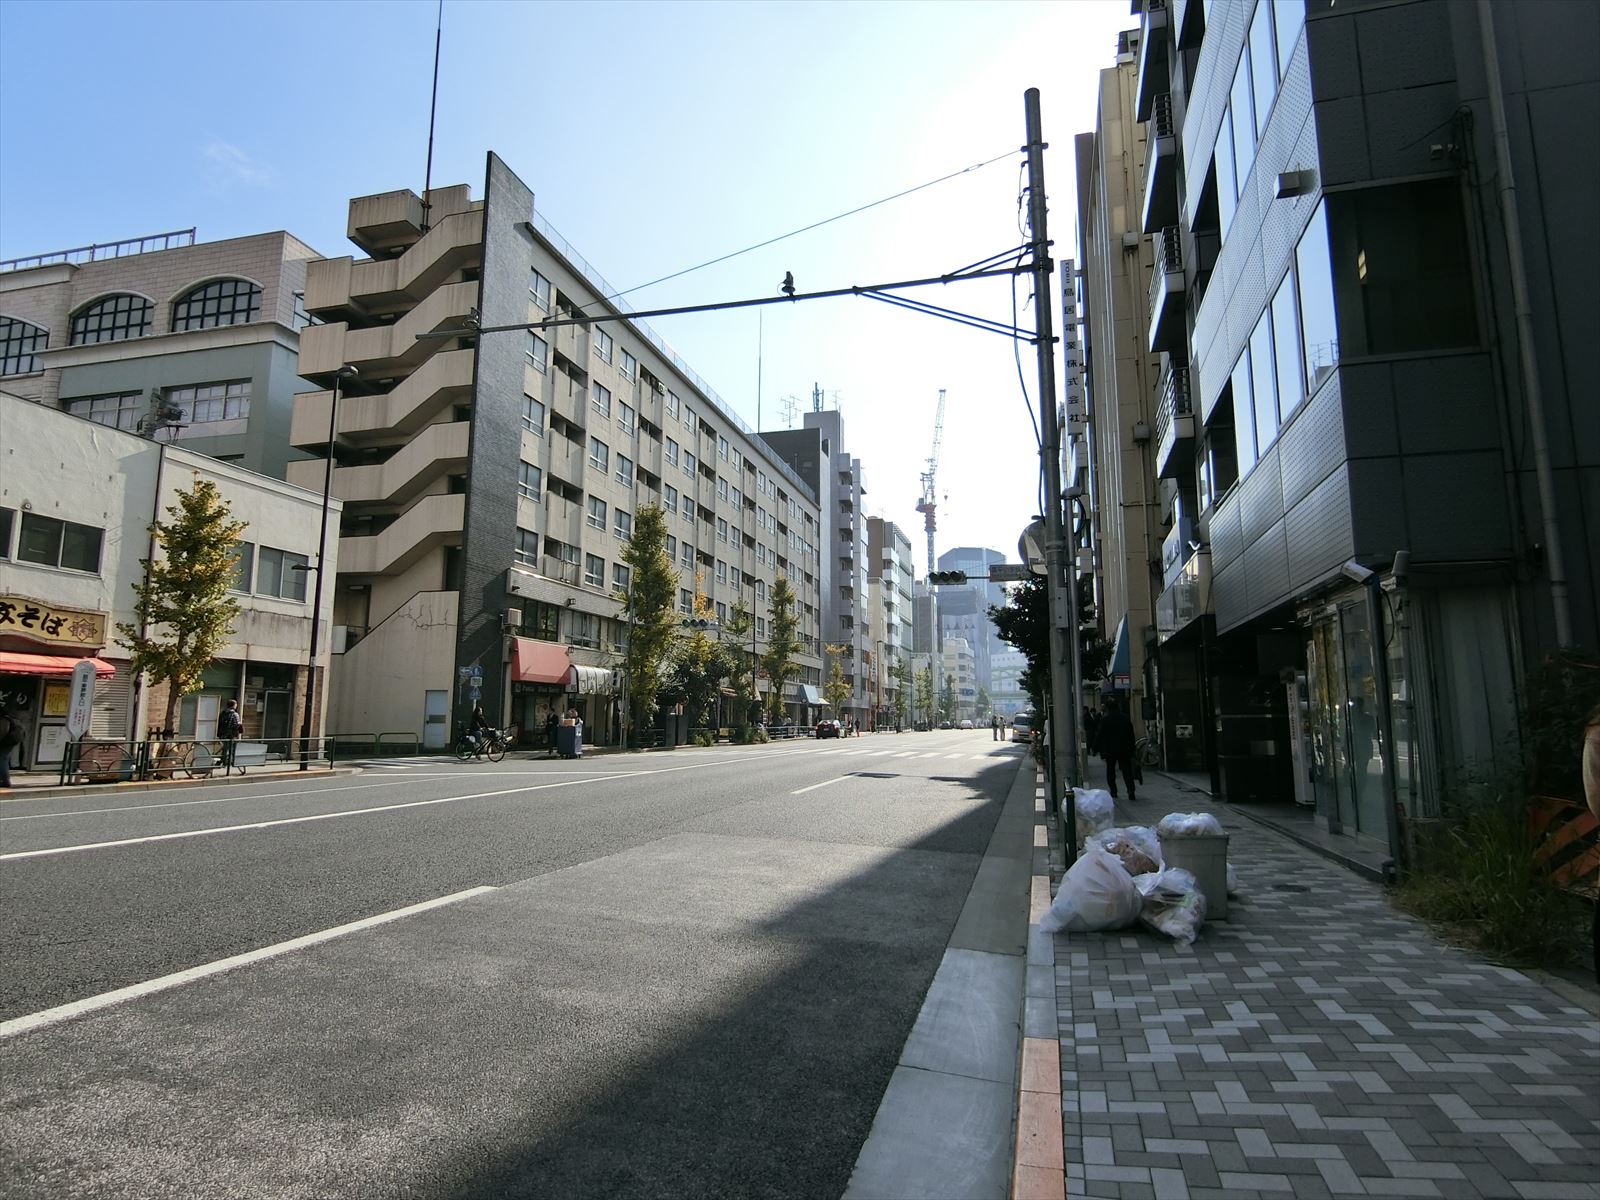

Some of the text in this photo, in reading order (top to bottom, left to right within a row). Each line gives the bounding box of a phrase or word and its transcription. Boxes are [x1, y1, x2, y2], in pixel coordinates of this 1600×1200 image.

[1064, 288, 1080, 423] 鳥居電業株式会社
